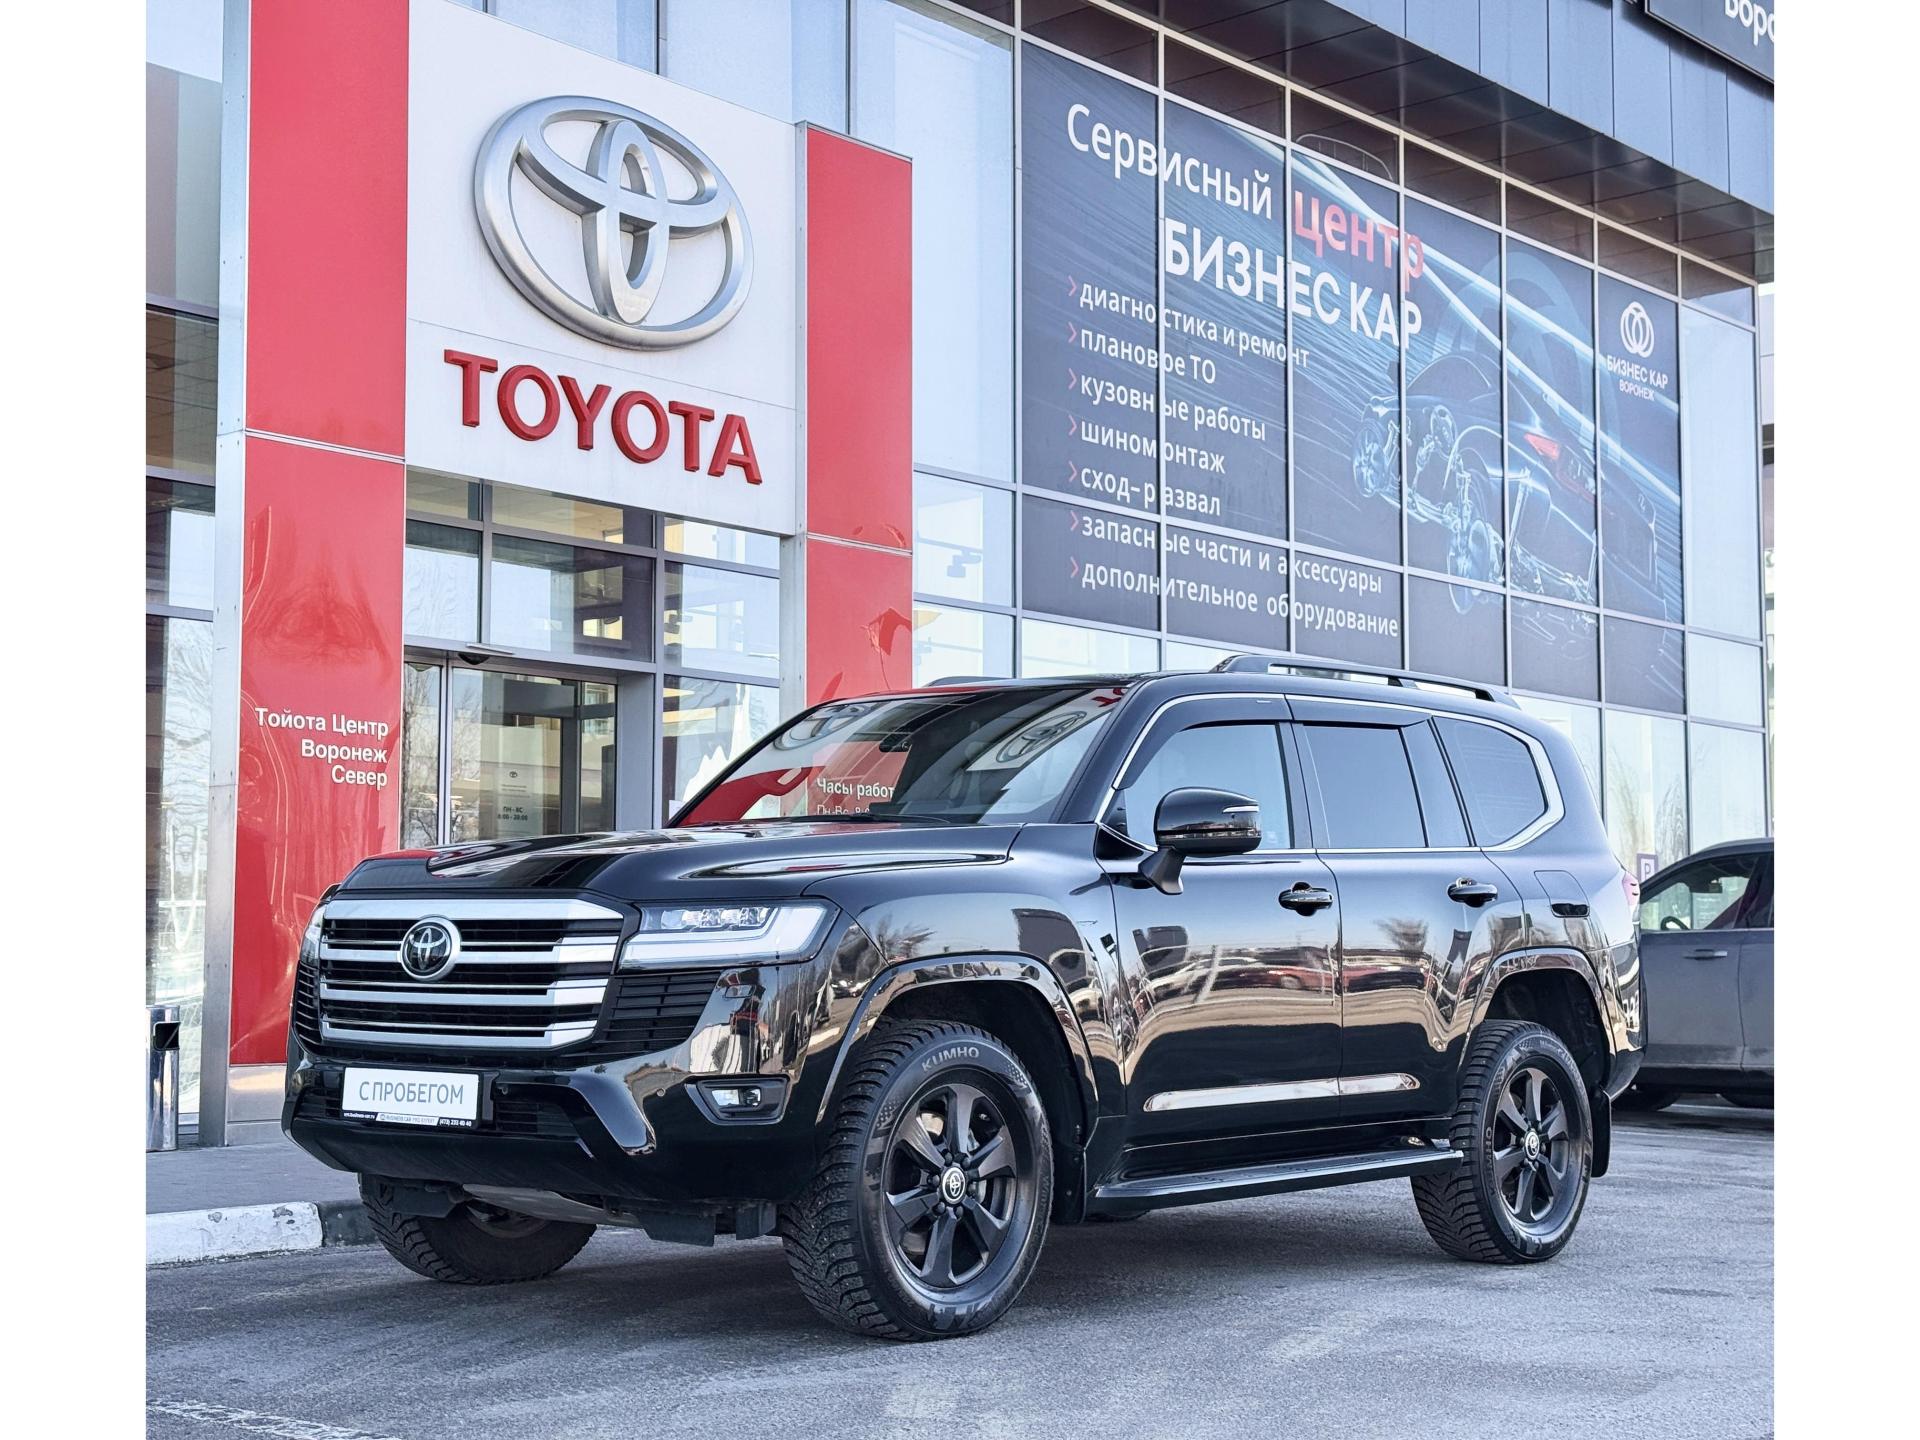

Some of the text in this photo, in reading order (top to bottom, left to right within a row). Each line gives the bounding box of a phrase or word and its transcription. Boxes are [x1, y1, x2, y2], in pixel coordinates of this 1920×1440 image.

[1067, 103, 1424, 292] Сервисный центр
[1164, 217, 1422, 349] БИЗНЕС КАР
[1080, 283, 1310, 368] диагностика и ремонт
[1081, 329, 1216, 384] плановое ТО
[1606, 354, 1668, 389] БИЗНЕС КАР
[444, 348, 762, 485] TOYOTA
[1081, 375, 1266, 441] кузовные работы
[1619, 379, 1654, 401] ВОРОНЕЖ
[1081, 420, 1226, 474] шиномонтаж
[1082, 516, 1382, 596] запасные части и аксессуары
[1082, 563, 1399, 637] дополнительное оборудование
[255, 707, 389, 740] Тойота Центр
[301, 738, 388, 765] Воронеж
[331, 765, 388, 789] Север
[817, 778, 853, 795] Часы
[922, 1046, 980, 1072] KUMHO
[359, 1081, 464, 1105] С ПРОБЕГОМ
